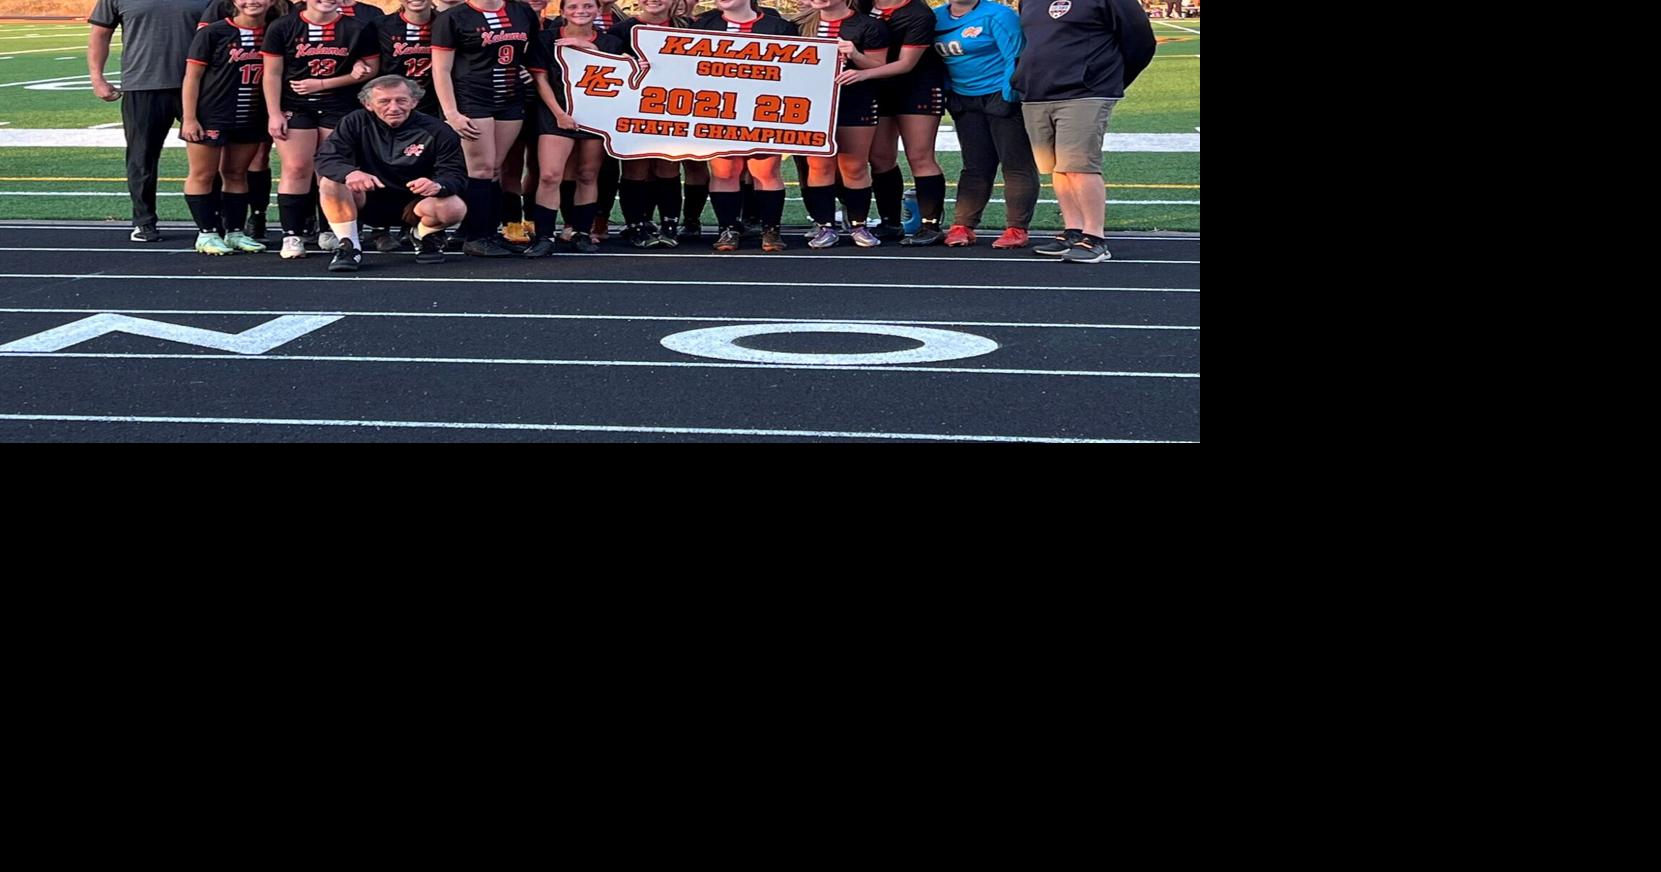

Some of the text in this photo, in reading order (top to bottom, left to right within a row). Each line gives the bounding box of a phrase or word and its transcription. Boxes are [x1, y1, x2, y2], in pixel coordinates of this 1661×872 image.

[498, 45, 514, 65] 9
[659, 36, 821, 65] KALAMA
[239, 64, 264, 84] 17
[308, 59, 337, 76] 13
[696, 61, 781, 81] SOCCER
[575, 65, 624, 97] KC
[639, 86, 811, 125] 2021 2B
[616, 117, 826, 147] STATE CHAMPIONS
